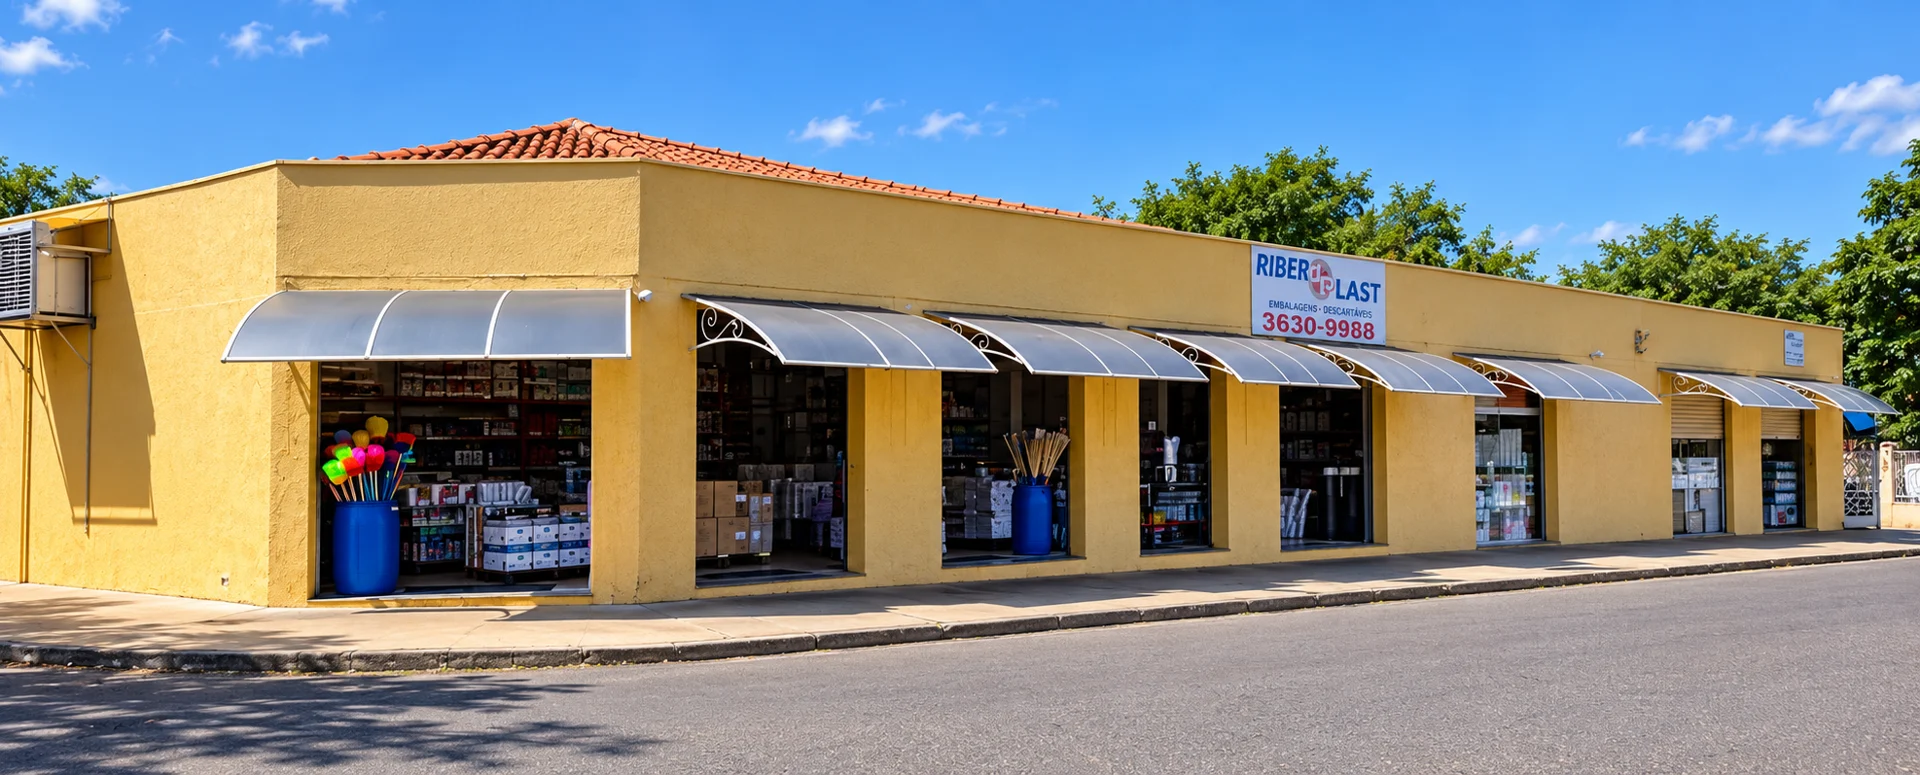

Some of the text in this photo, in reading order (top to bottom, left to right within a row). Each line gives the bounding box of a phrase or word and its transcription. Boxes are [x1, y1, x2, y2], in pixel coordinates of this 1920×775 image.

[1256, 253, 1310, 281] RIBER
[1335, 278, 1381, 304] LAST
[1268, 300, 1318, 312] EMBALAGENS
[1262, 312, 1375, 340] 3630-9988
